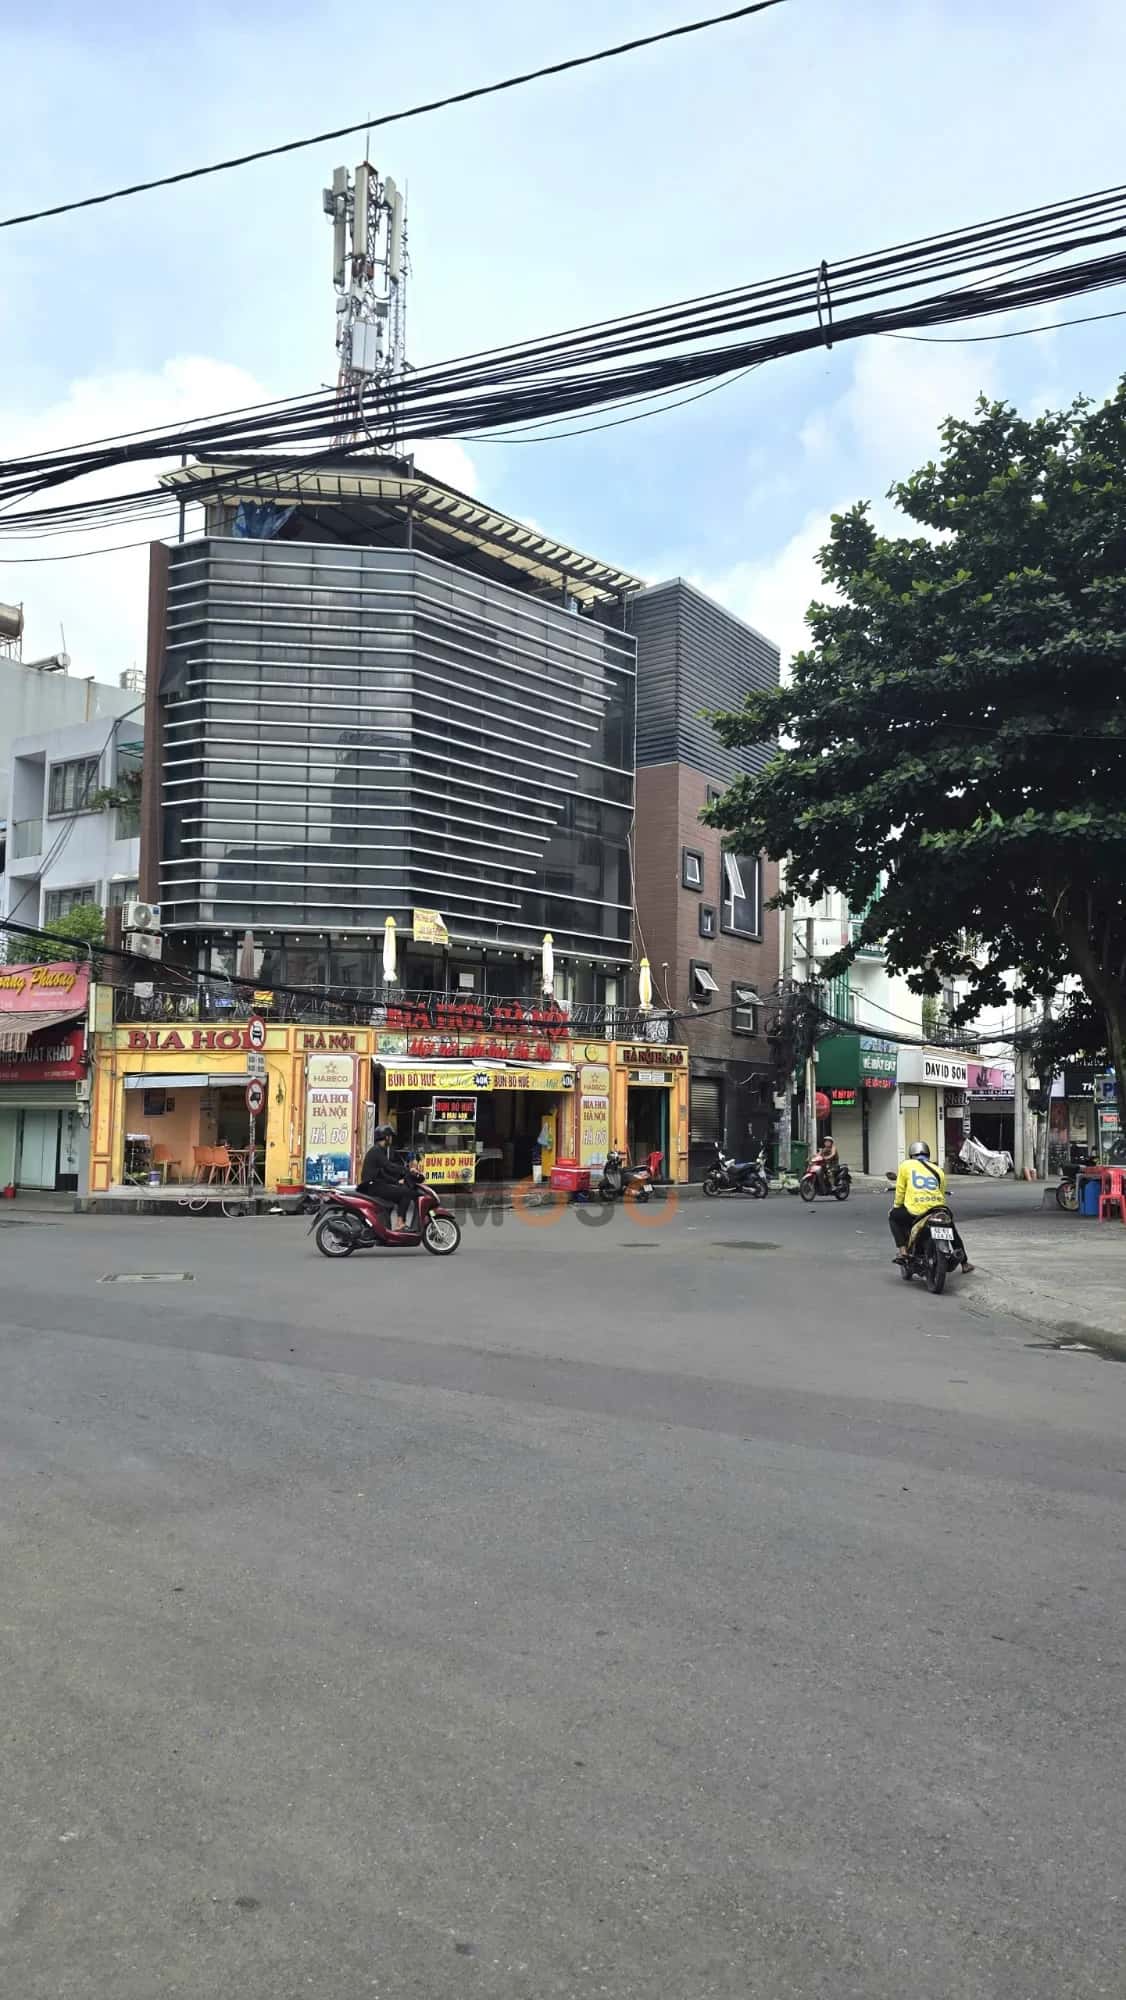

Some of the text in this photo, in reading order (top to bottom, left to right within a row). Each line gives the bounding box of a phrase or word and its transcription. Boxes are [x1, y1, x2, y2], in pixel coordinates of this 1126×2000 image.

[128, 1029, 252, 1050] BIA HƠI
[303, 1031, 356, 1052] HÀ NỘI
[312, 1075, 348, 1083] HABECO
[925, 1061, 967, 1082] DAVID SON
[312, 1094, 329, 1104] BIA
[312, 1104, 348, 1120] HÀ NỘI
[912, 1170, 938, 1191] be
